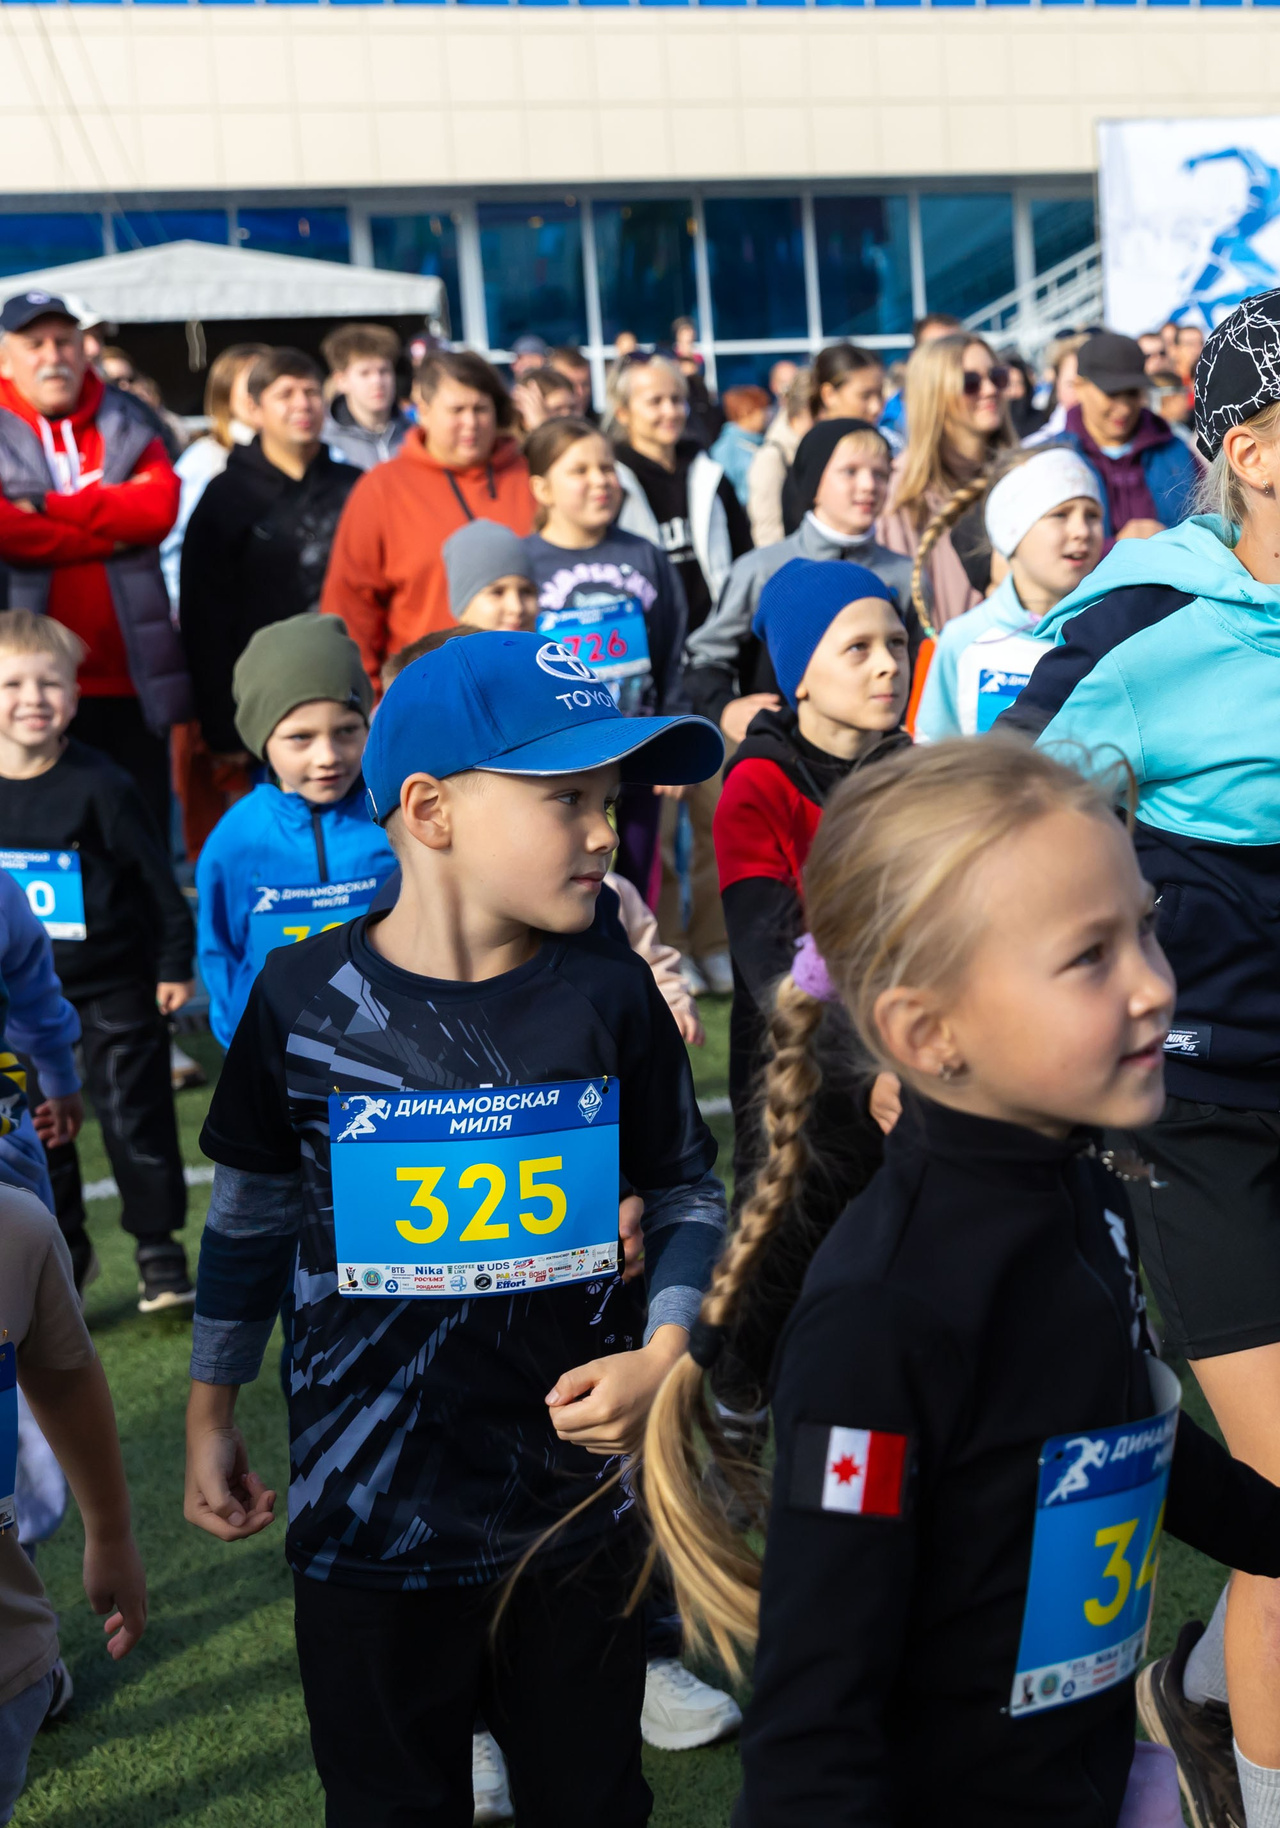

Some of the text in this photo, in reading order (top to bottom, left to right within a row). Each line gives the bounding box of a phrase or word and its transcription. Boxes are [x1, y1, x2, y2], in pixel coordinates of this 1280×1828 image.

[562, 630, 628, 662] 726
[281, 878, 377, 900] ДИНАМОВСКАЯ
[25, 880, 56, 917] 0
[312, 894, 350, 909] МИЛЯ
[1166, 1033, 1193, 1043] NIKE
[1181, 1044, 1196, 1052] SB
[394, 1089, 560, 1118] ДИНАМОВСКАЯ
[450, 1114, 513, 1135] МИЛЯ
[395, 1156, 568, 1244] 325
[391, 1266, 406, 1274] ВТБ
[415, 1265, 444, 1275] Nika
[487, 1261, 510, 1271] UDS
[496, 1280, 527, 1290] Effort
